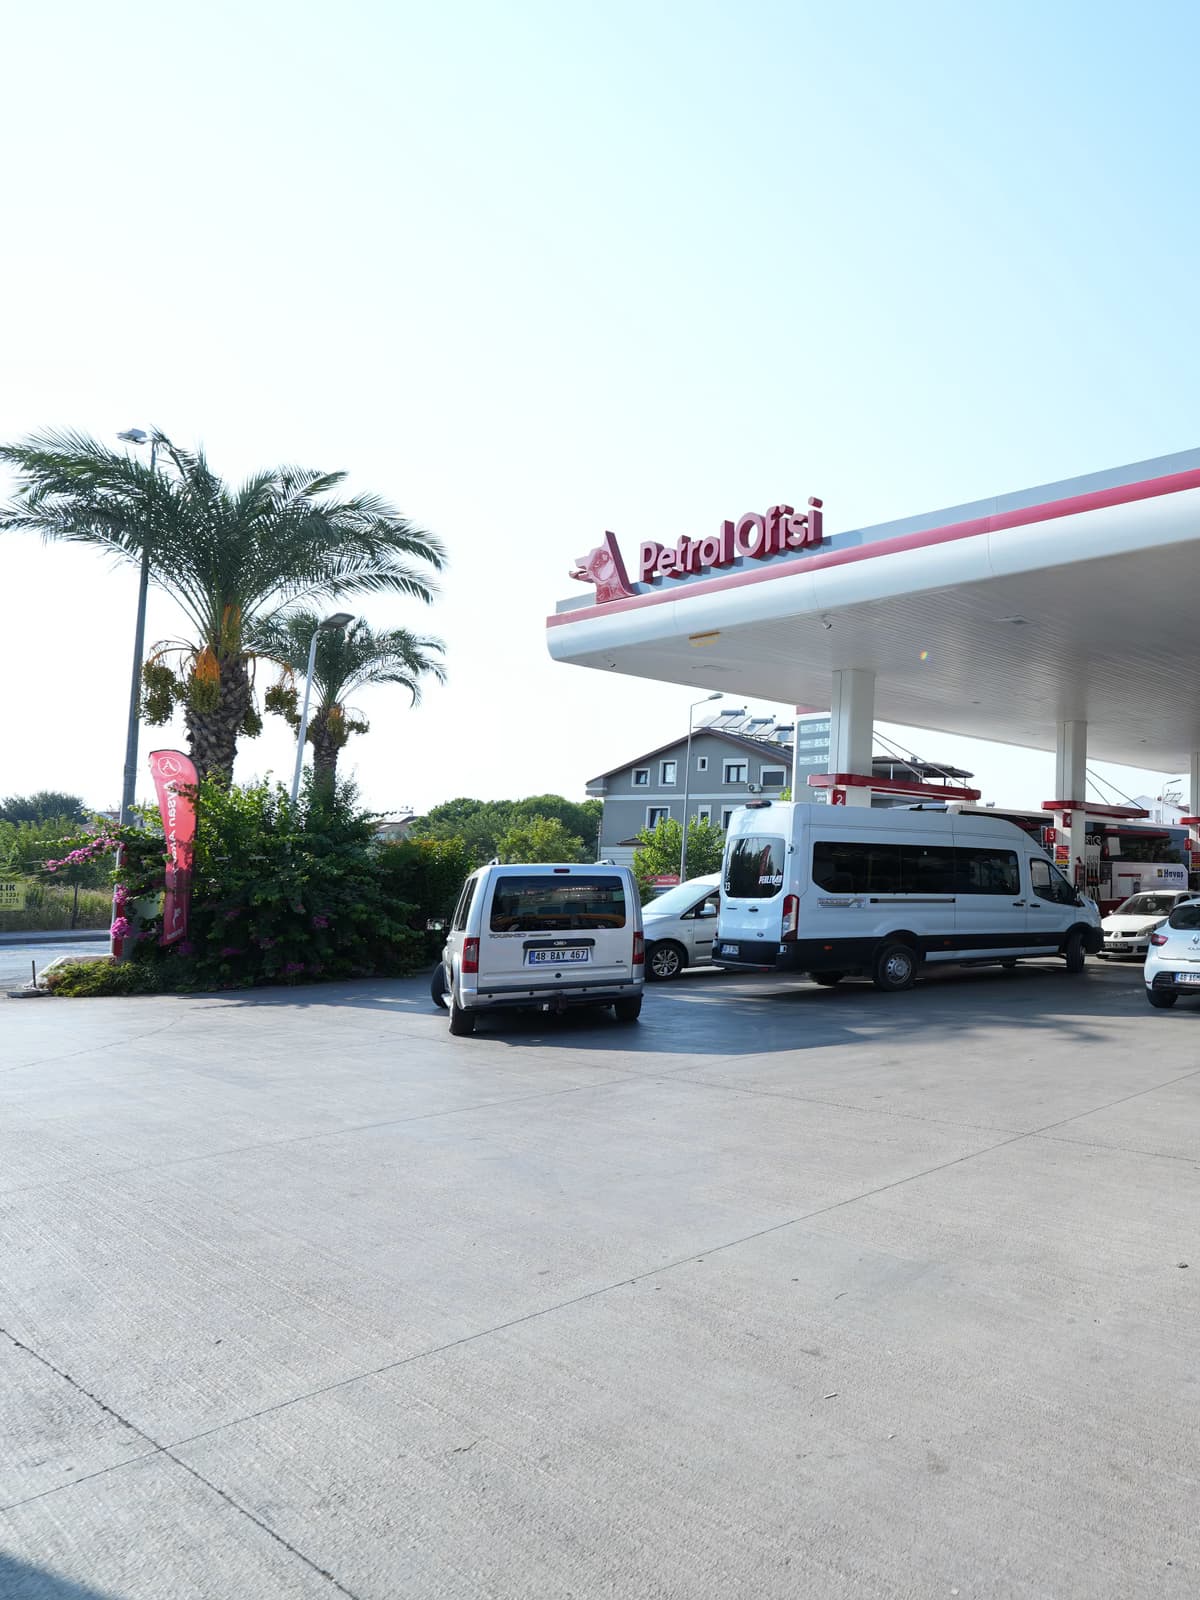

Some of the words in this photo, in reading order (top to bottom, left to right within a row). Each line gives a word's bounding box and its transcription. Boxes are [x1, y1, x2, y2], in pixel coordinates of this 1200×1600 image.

[639, 520, 735, 583] Petrol
[735, 496, 823, 561] Ofisi
[1163, 868, 1184, 880] Havaş
[535, 952, 546, 961] 48
[550, 951, 566, 961] BAY
[570, 950, 586, 960] 467
